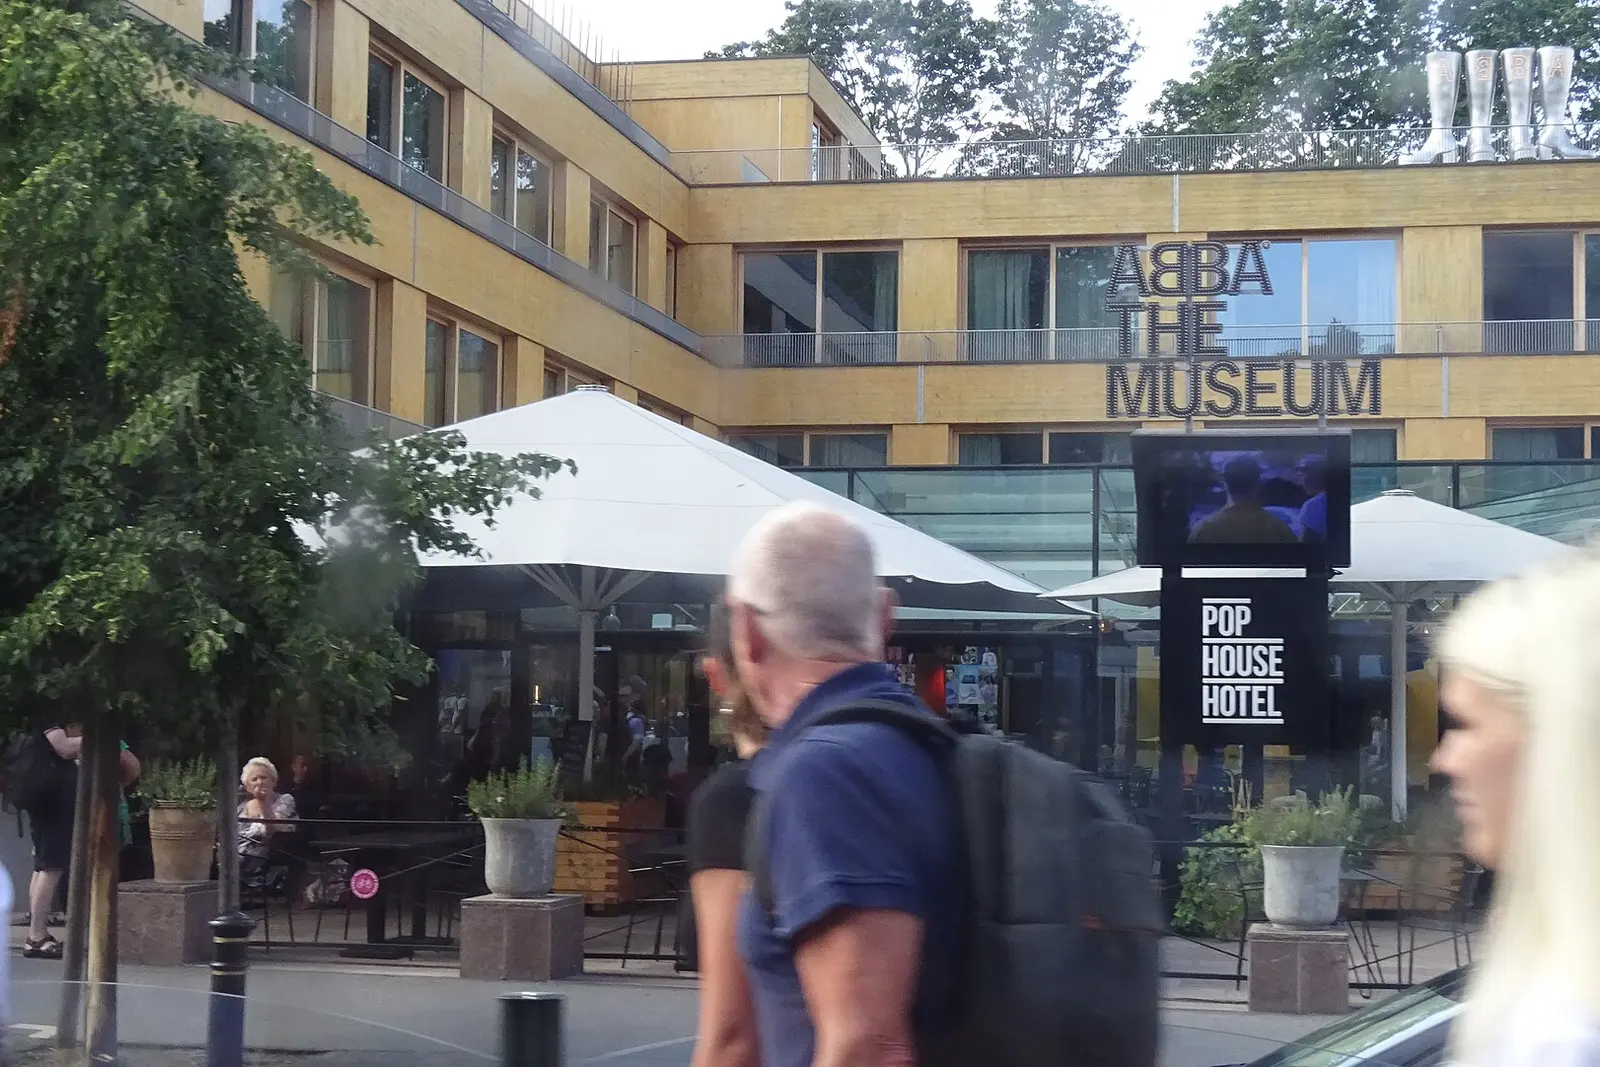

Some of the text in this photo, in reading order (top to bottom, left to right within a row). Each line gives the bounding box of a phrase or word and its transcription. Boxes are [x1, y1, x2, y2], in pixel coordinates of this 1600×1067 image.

[1106, 301, 1227, 357] THE
[1106, 359, 1381, 418] MUSEUM
[1202, 605, 1252, 637] POP
[1202, 645, 1284, 677] HOUSE
[1202, 685, 1282, 717] HOTEL
